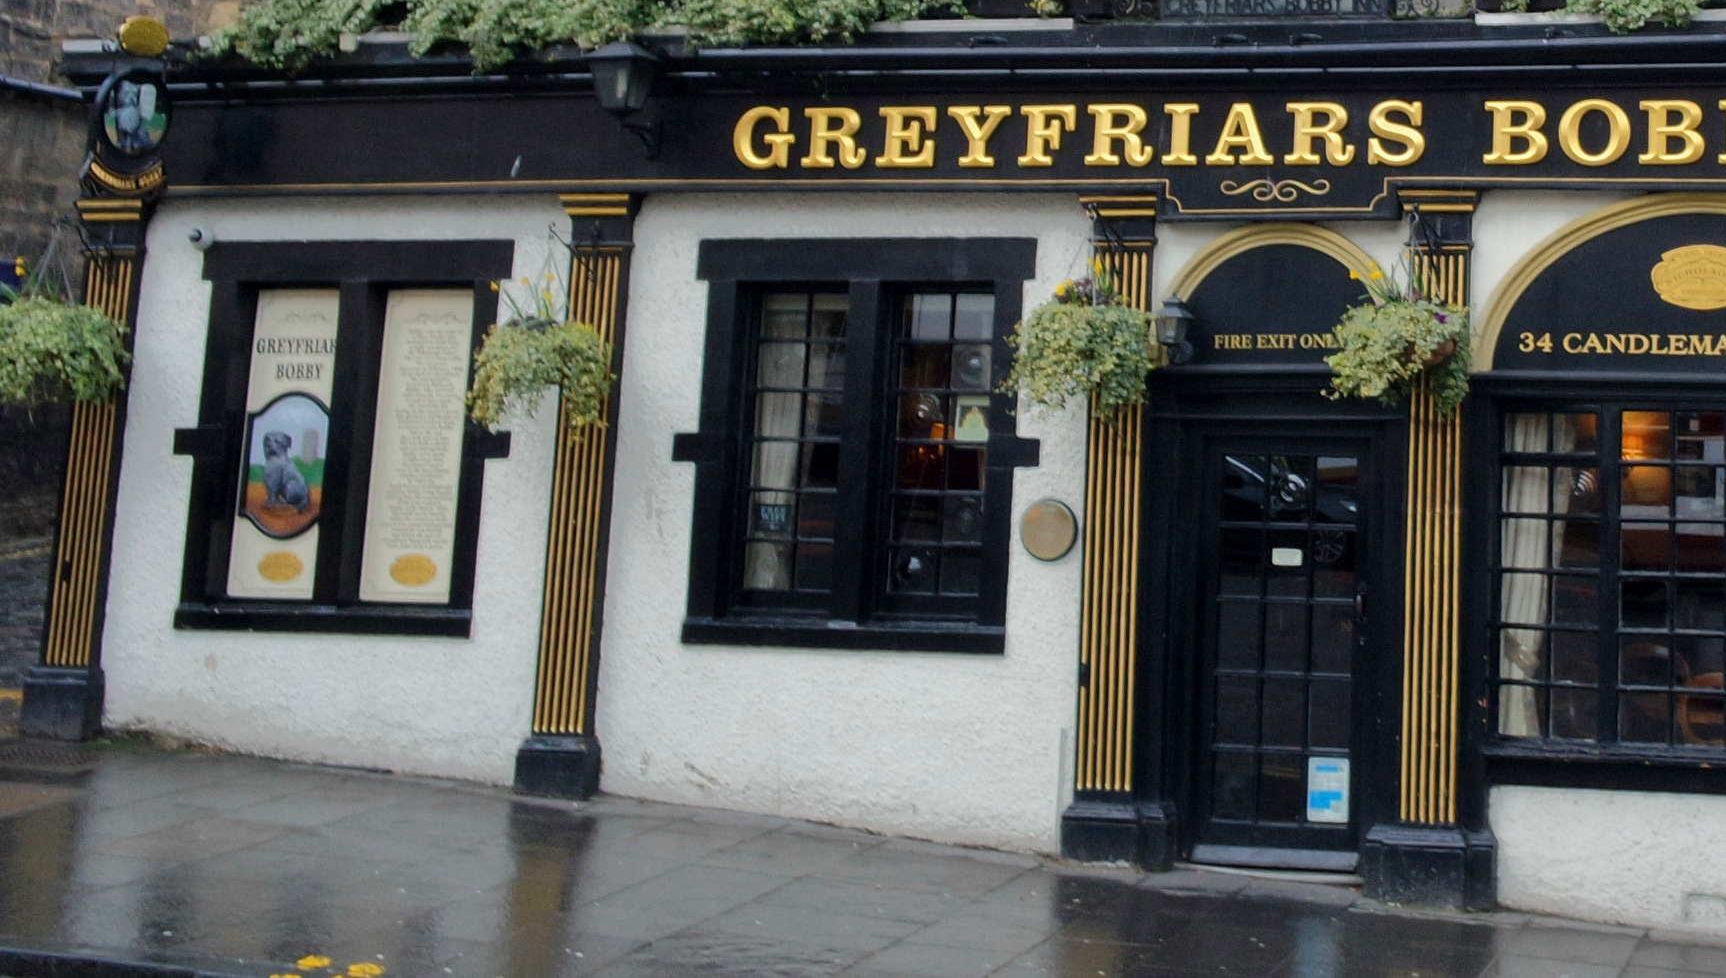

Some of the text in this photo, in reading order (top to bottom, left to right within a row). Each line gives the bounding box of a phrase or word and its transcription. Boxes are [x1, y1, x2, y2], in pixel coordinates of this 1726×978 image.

[732, 100, 1425, 168] GREYFRIARS
[1214, 333, 1342, 349] FIRE EXIT ONL
[1519, 332, 1553, 353] 34
[276, 362, 322, 380] BOBBY
